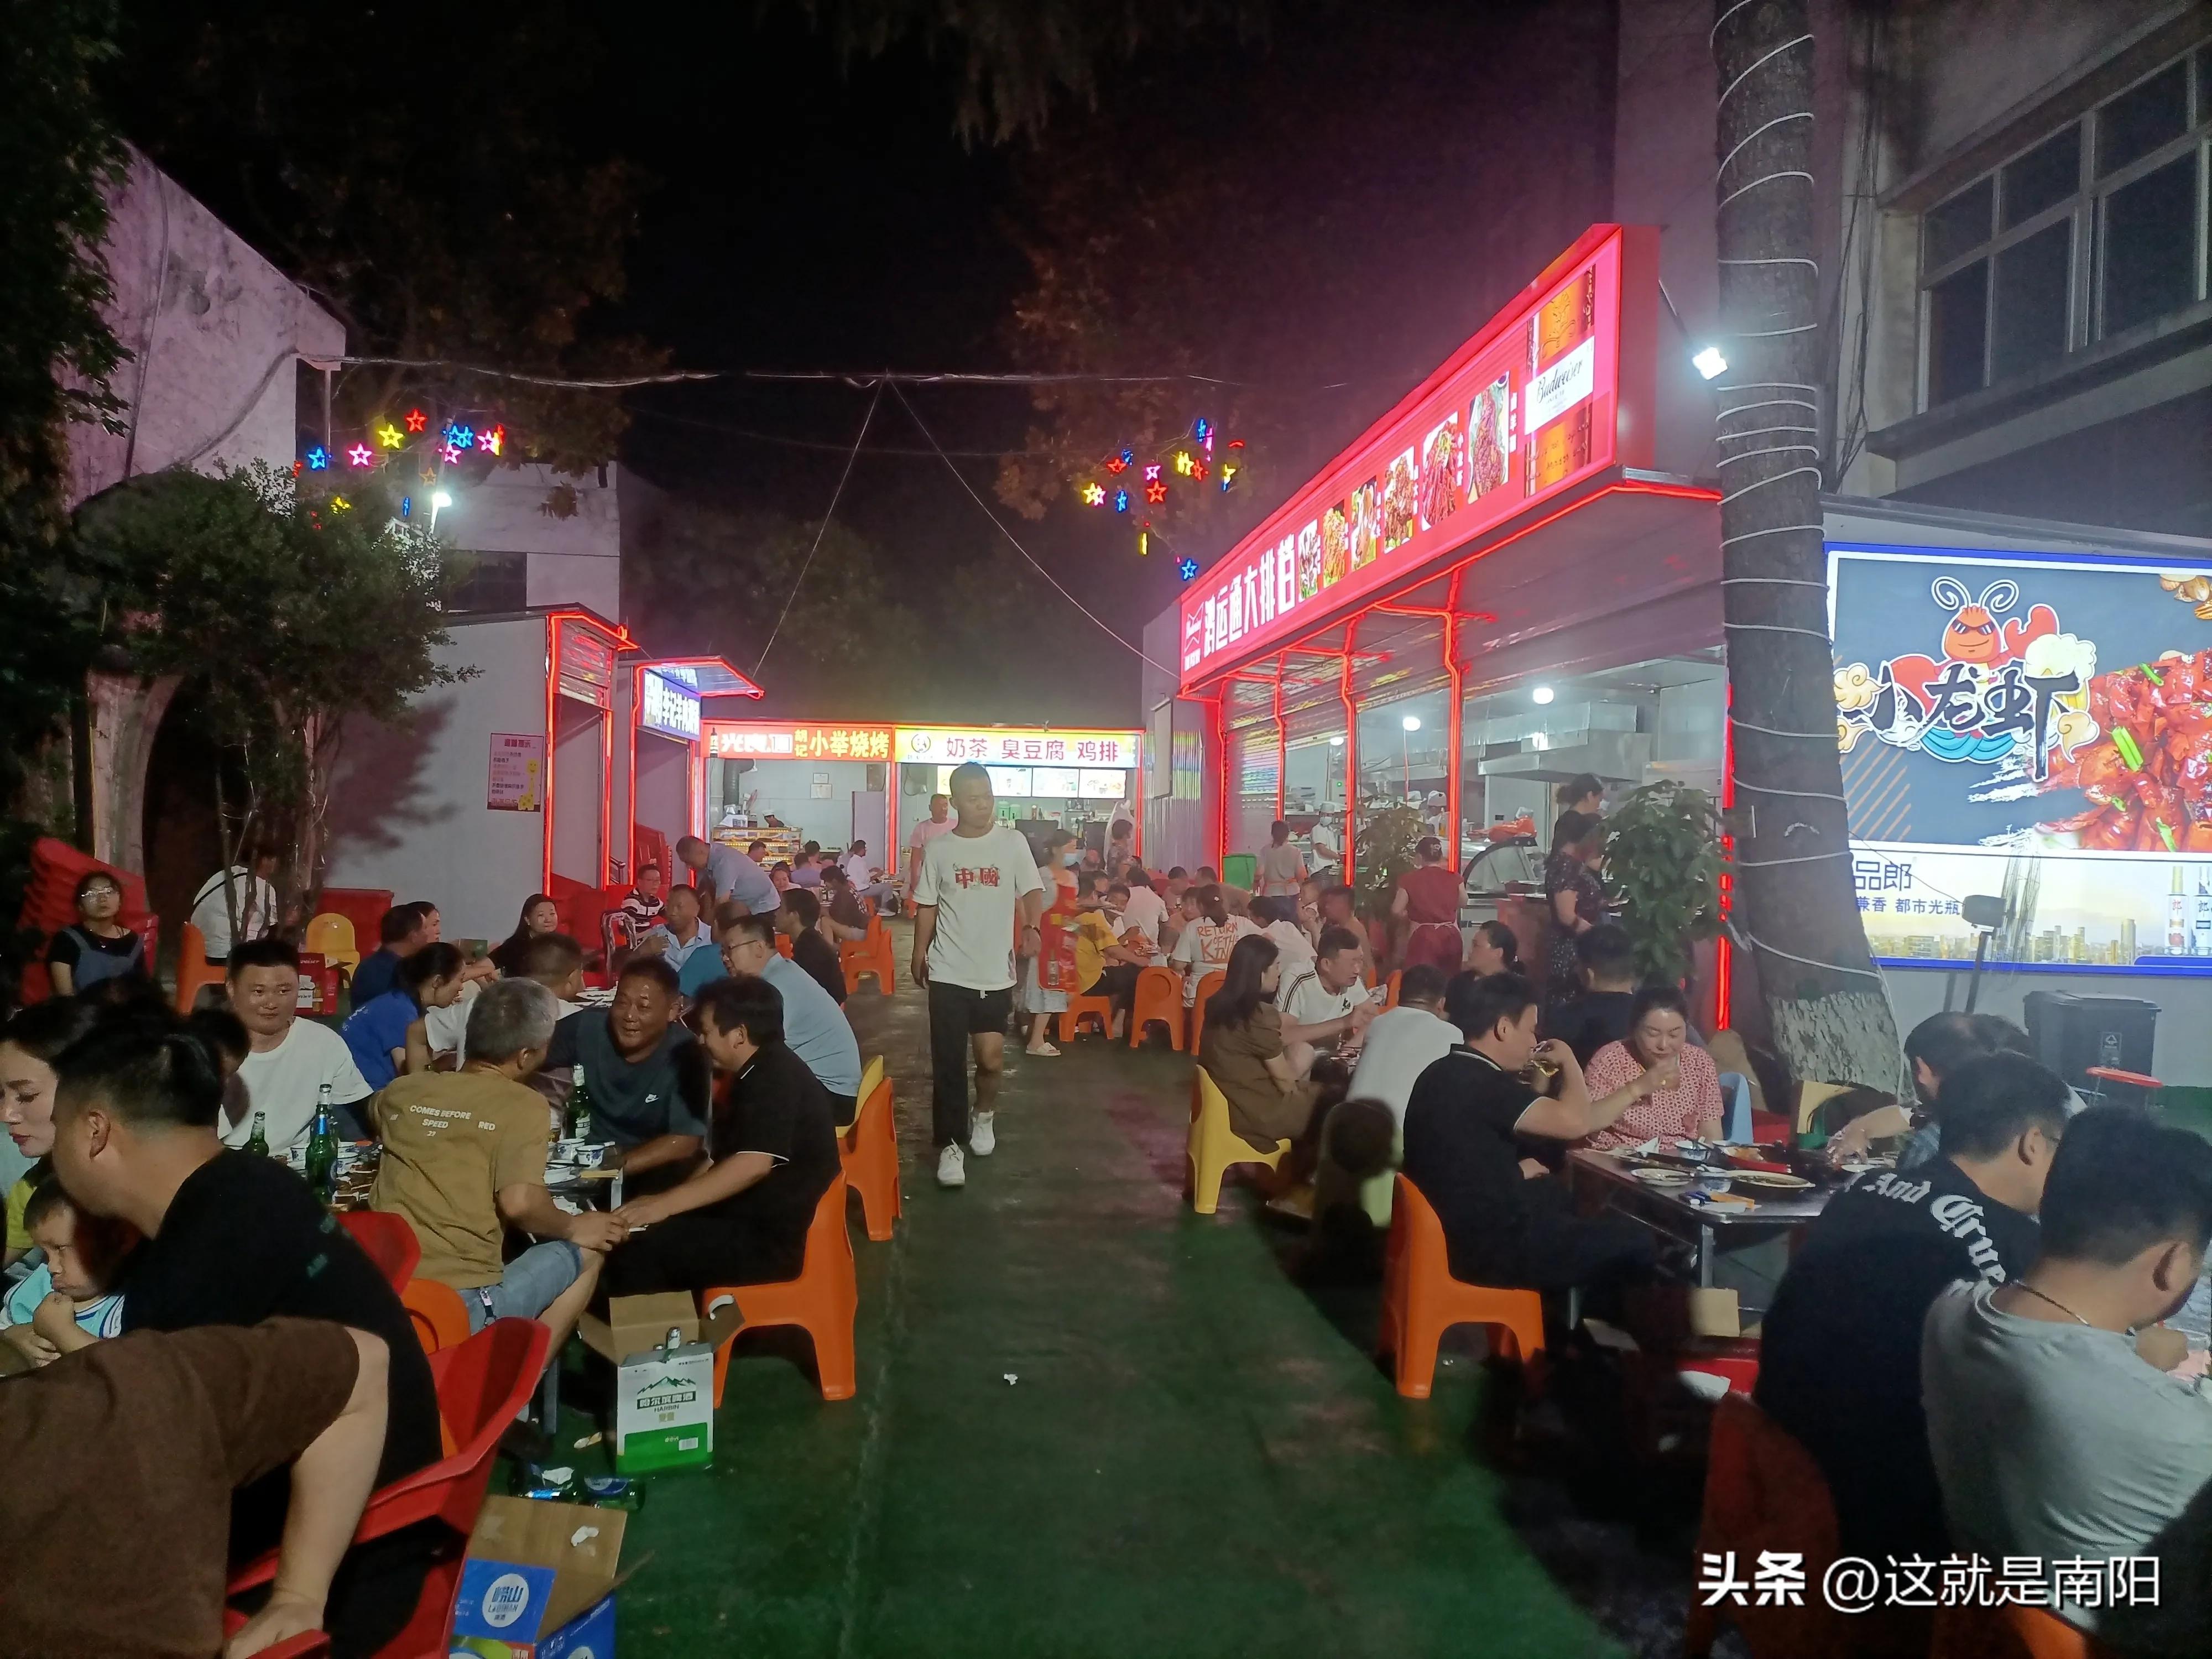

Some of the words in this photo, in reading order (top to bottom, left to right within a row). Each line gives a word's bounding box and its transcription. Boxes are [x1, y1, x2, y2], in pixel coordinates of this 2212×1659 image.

[1537, 358, 1583, 404] Budweiser
[1843, 662, 2081, 780] 小龙虾
[946, 737, 988, 759] 奶茶
[1001, 739, 1065, 761] 臭豆腐
[1077, 740, 1119, 762] 鸡排
[1895, 898, 1960, 916] 都市光瓶
[410, 1105, 440, 1117] COMES
[441, 1110, 472, 1120] BEFORE
[422, 1119, 448, 1129] SPEED
[478, 1121, 496, 1131] RED
